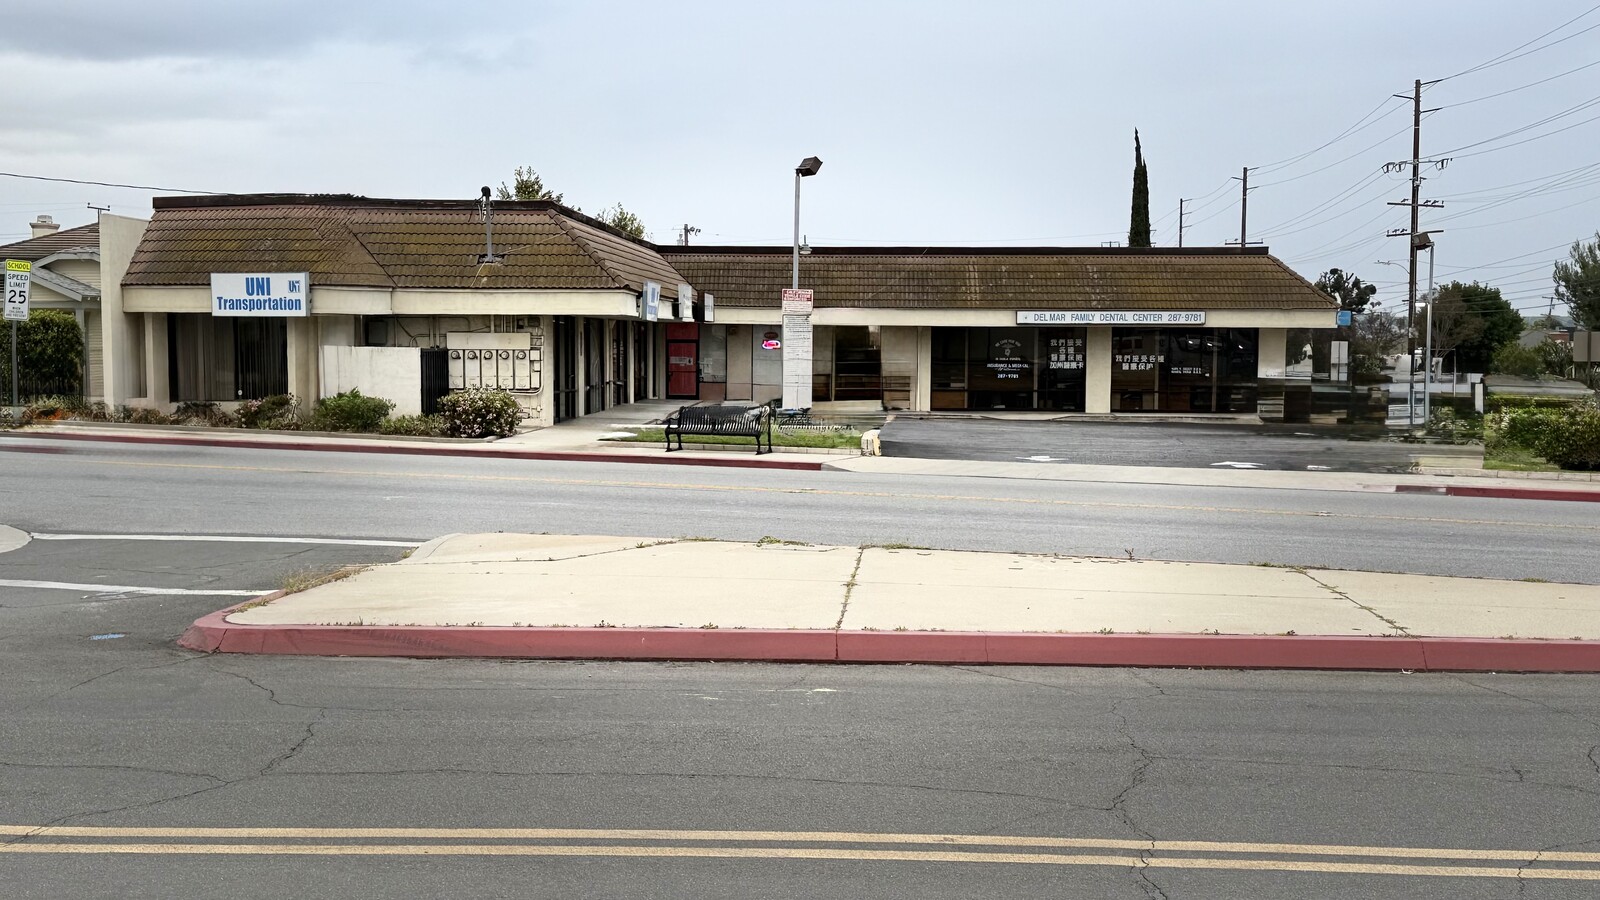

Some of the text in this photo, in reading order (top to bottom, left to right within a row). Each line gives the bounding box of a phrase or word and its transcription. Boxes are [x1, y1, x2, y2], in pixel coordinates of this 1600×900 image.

[8, 262, 30, 270] SCHOOL
[245, 277, 271, 296] UNI
[8, 290, 26, 304] 25
[217, 297, 301, 312] Transportation
[1070, 313, 1095, 322] FAMILY
[1099, 313, 1128, 322] DENTAL
[1132, 313, 1163, 322] CENTER
[1167, 313, 1202, 322] 287-9781
